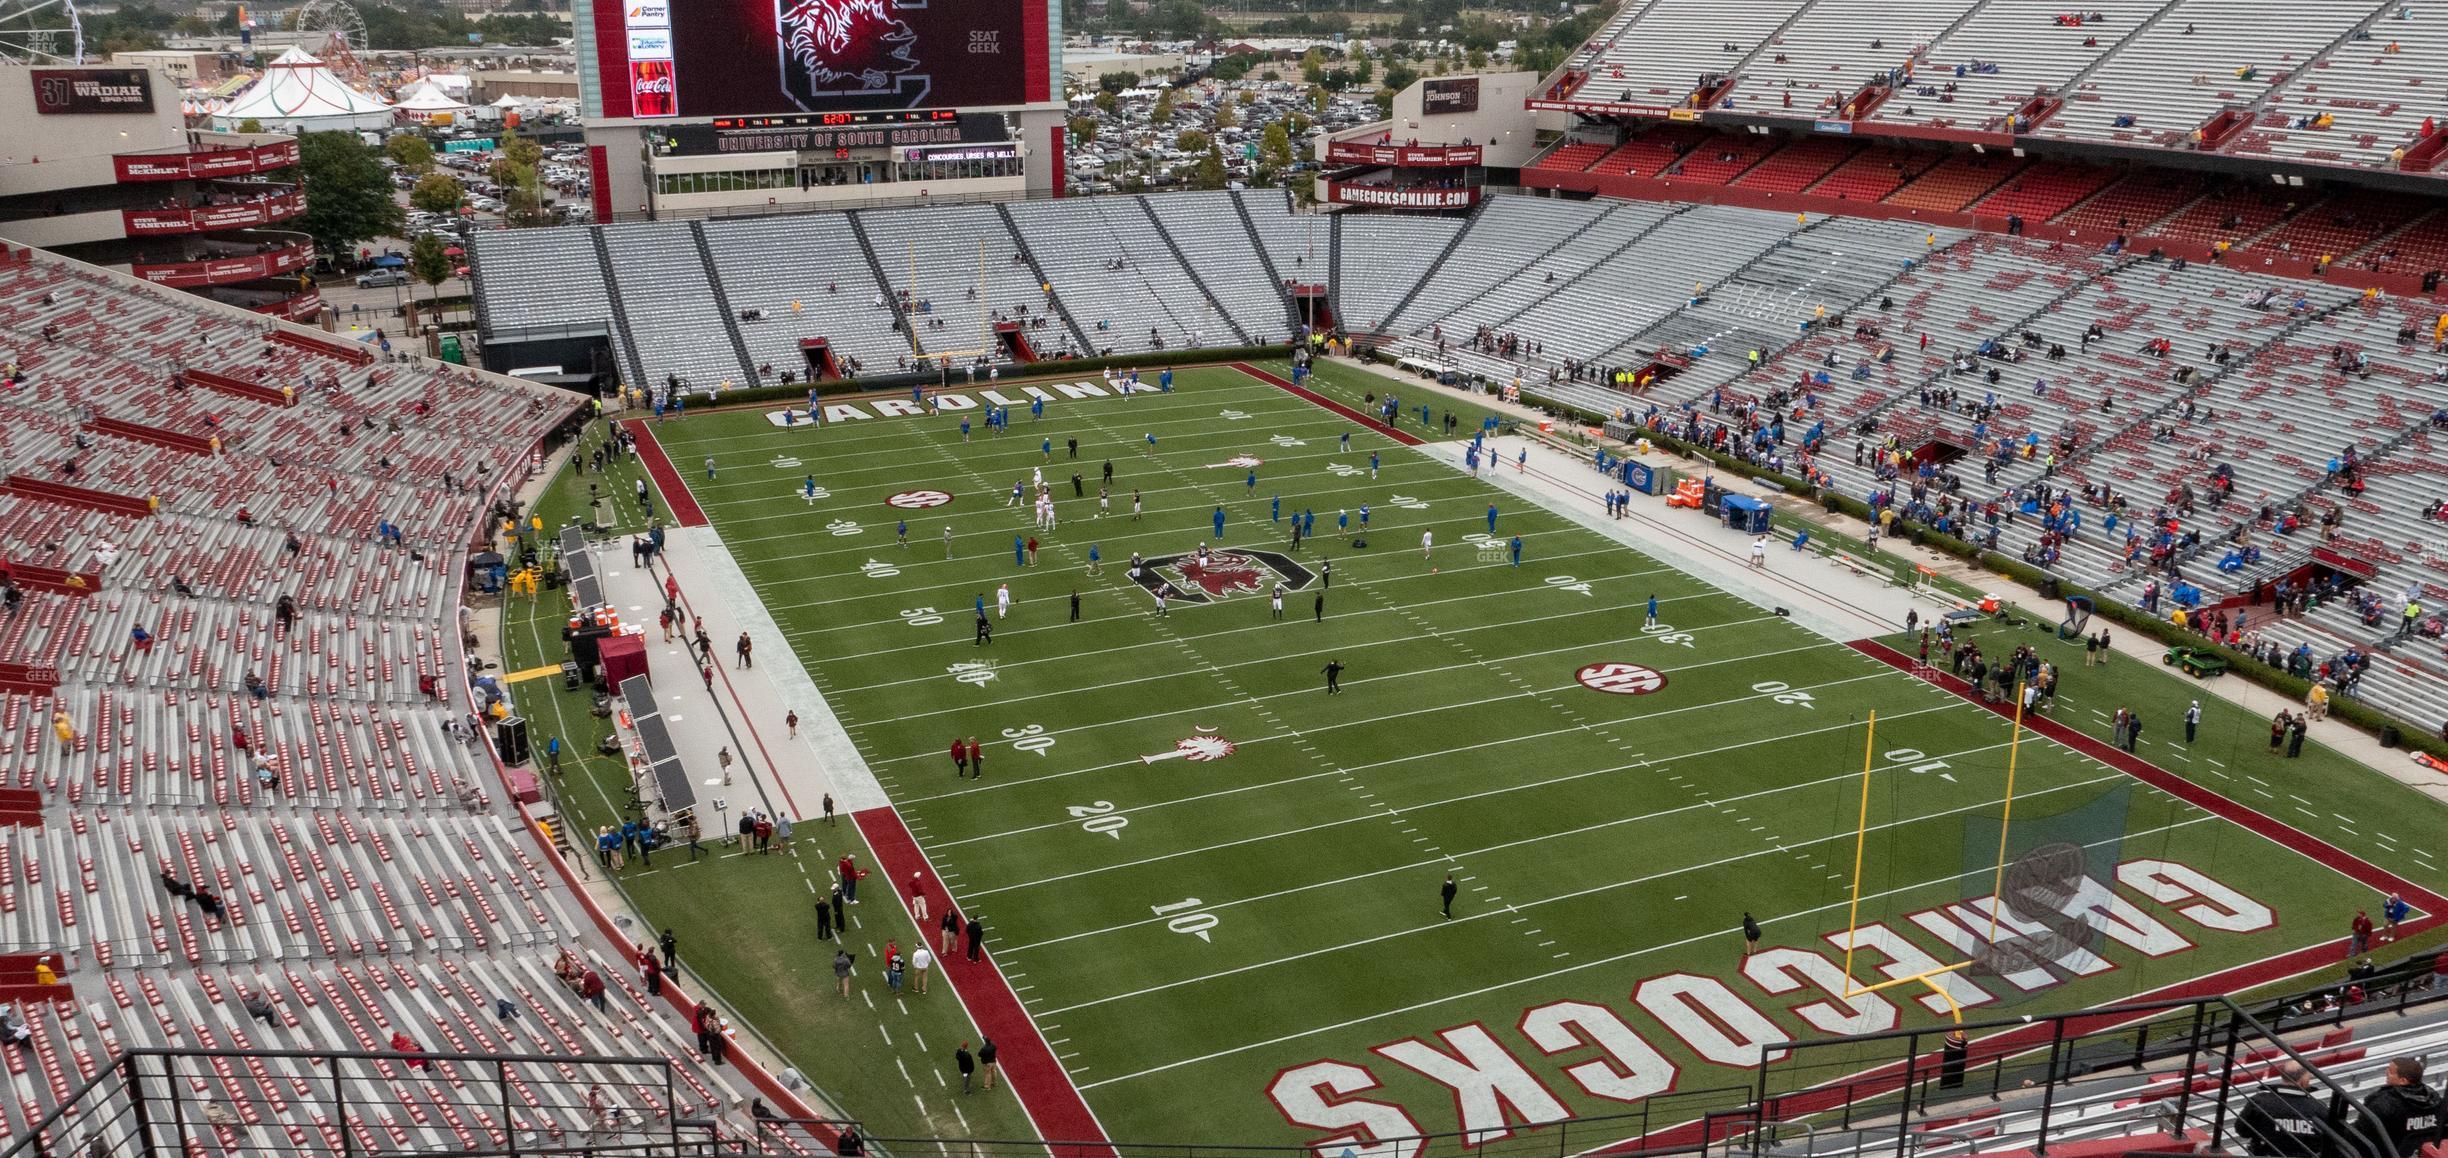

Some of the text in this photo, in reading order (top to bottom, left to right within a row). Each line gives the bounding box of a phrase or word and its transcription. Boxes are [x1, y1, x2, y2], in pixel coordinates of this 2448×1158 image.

[41, 77, 70, 106] 37
[74, 86, 142, 97] WADIAK
[1426, 92, 1461, 102] JOHNSON
[823, 113, 851, 124] 62:07
[718, 127, 961, 151] UNIVERSITY OF SOUTH CAROLINA
[128, 167, 180, 175] McKINLEY
[1340, 188, 1469, 206] GAMECOCKSONLINE.COM
[134, 221, 189, 229] TANEYHILL
[765, 380, 1162, 428] CAROLINA
[825, 521, 864, 537] 30
[859, 562, 901, 578] 40
[1545, 575, 1592, 593] 40
[899, 606, 944, 626] 50
[1640, 624, 1695, 644] 30
[945, 663, 995, 683] 40
[1580, 663, 1663, 694] SEC
[1751, 681, 1816, 705] 20
[1001, 724, 1056, 751] 30
[1884, 748, 1952, 774] 10
[1065, 800, 1129, 833] 20
[1150, 897, 1219, 934] 10
[1264, 856, 2280, 1158] GAMECOCKS
[2274, 1118, 2316, 1135] POLICE
[2406, 1114, 2438, 1131] POLICE
